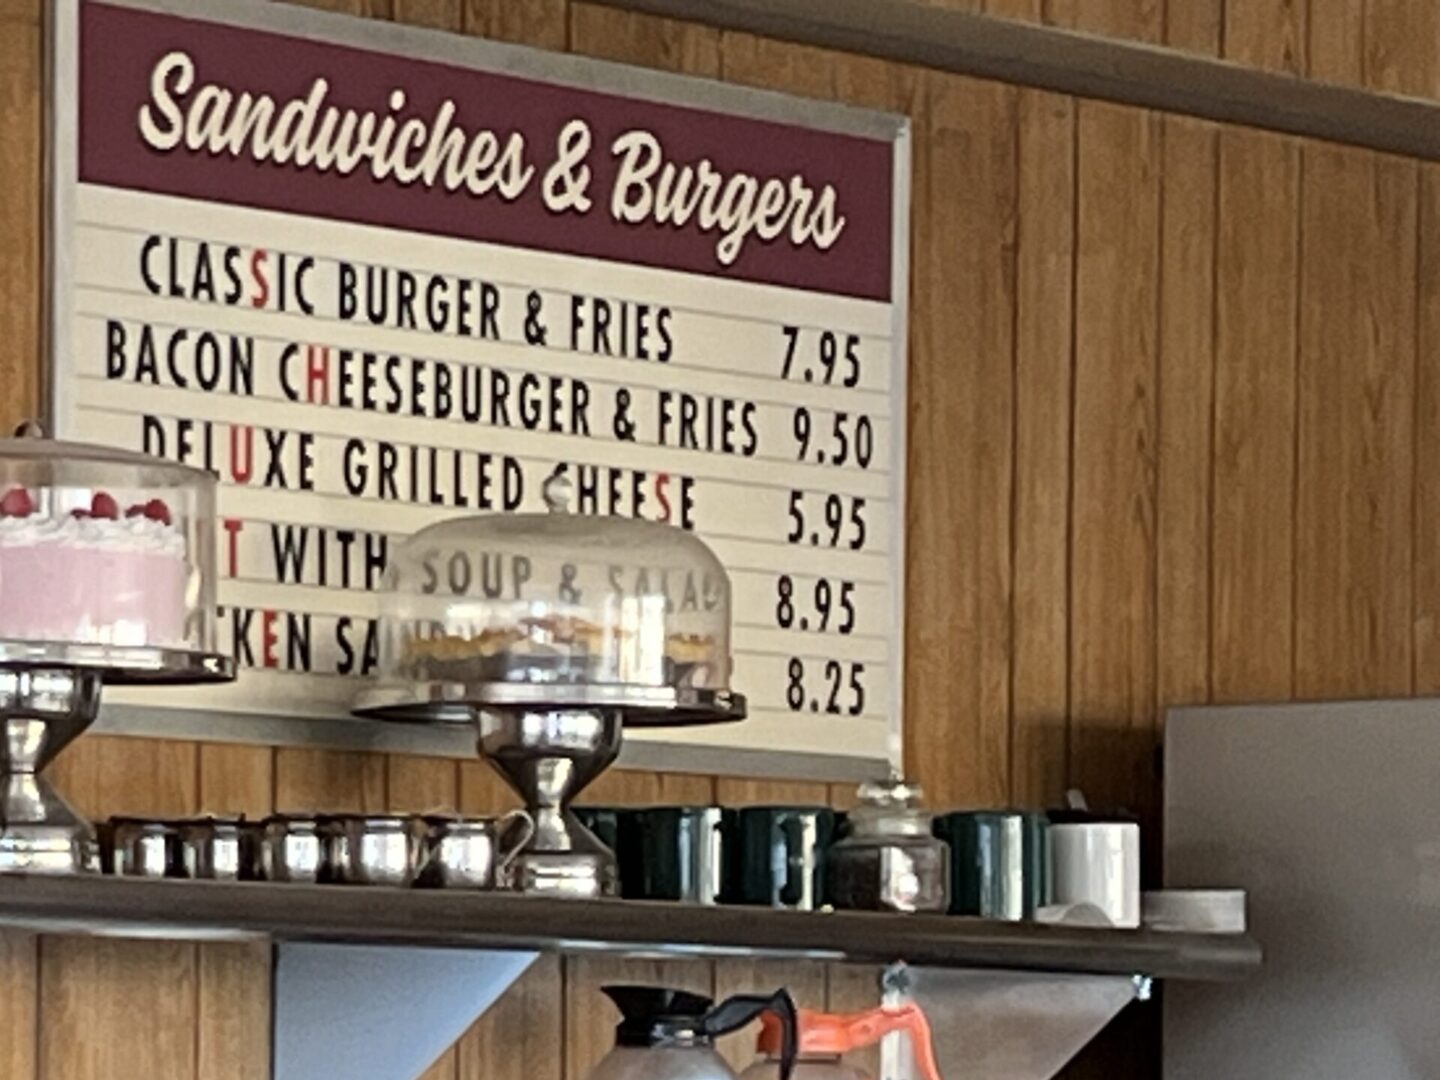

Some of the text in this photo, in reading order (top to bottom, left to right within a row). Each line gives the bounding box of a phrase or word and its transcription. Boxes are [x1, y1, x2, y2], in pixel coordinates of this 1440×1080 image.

[138, 51, 847, 265] Sandwiches & Burgers
[140, 234, 862, 388] CLASSIC BURGER & FRIES 7.95
[106, 320, 873, 468] BACON CHEESEBURGER & FRIES 9.50
[143, 415, 315, 490] DELUXE
[343, 438, 523, 511] GRILLED
[788, 490, 866, 550] 5.95
[271, 523, 388, 590] WITH
[422, 550, 532, 599] SOUP
[559, 563, 583, 604] &
[776, 575, 856, 635] 8.95
[786, 660, 866, 718] 8.25
